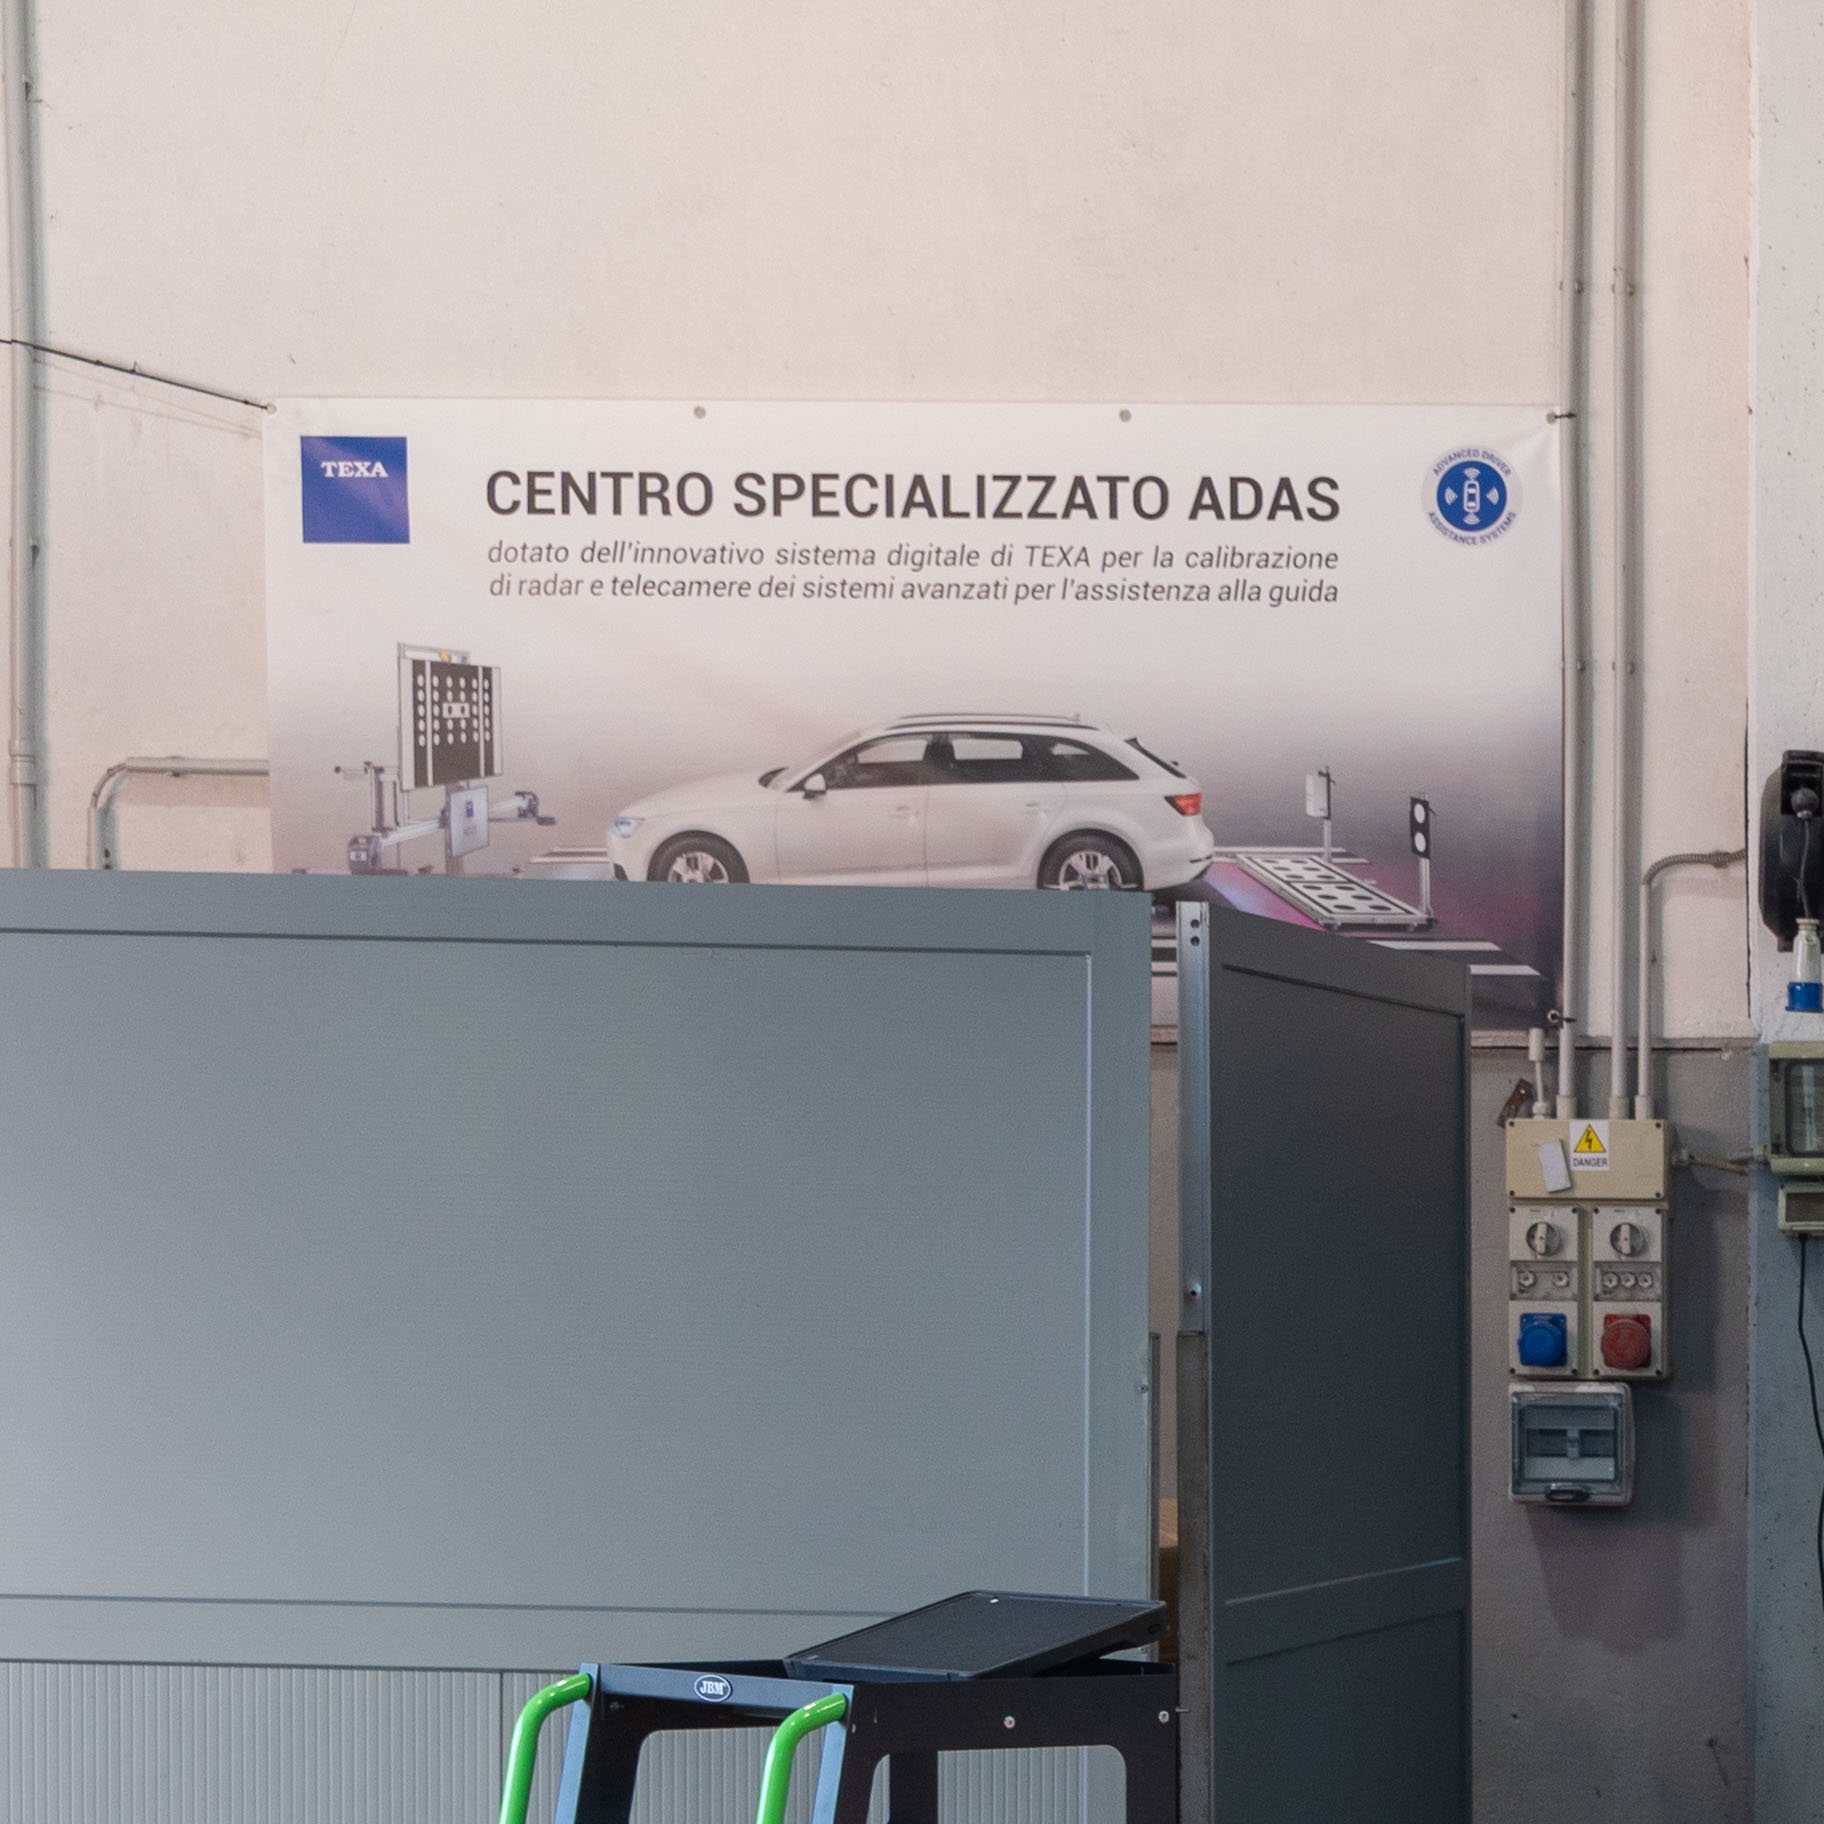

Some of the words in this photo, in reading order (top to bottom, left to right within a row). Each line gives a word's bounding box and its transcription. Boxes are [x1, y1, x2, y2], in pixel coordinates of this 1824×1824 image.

[320, 460, 389, 479] TEXA
[1432, 448, 1480, 476] ADVANCED
[1481, 450, 1512, 476] DRIVER
[486, 471, 714, 518] CENTRO
[733, 473, 1169, 521] SPECIALIZZATO
[1188, 476, 1341, 522] ADAS
[1428, 511, 1477, 546] ASSISTANCE
[1480, 511, 1517, 545] SYSTEMS
[487, 540, 570, 564] dotato
[580, 540, 765, 565] dell'innovativo
[775, 543, 876, 567] sistema
[887, 544, 980, 573] digitale
[990, 545, 1013, 567] di
[1024, 546, 1091, 568] TEXA
[1101, 550, 1143, 574] per
[1153, 545, 1174, 569] la
[1185, 546, 1339, 570] calibrazione
[489, 573, 512, 597] di
[518, 573, 585, 597] radar
[589, 579, 604, 597] e
[611, 574, 752, 598] telecamere
[757, 575, 796, 599] dei
[802, 576, 895, 600] sistemi
[900, 577, 1009, 601] avanzati
[1013, 580, 1056, 606] per
[1062, 577, 1211, 602] l'assistenza
[1217, 579, 1262, 602] alla
[1268, 580, 1339, 608] guida
[1573, 1158, 1608, 1168] DANGER
[699, 1680, 725, 1696] JBM
